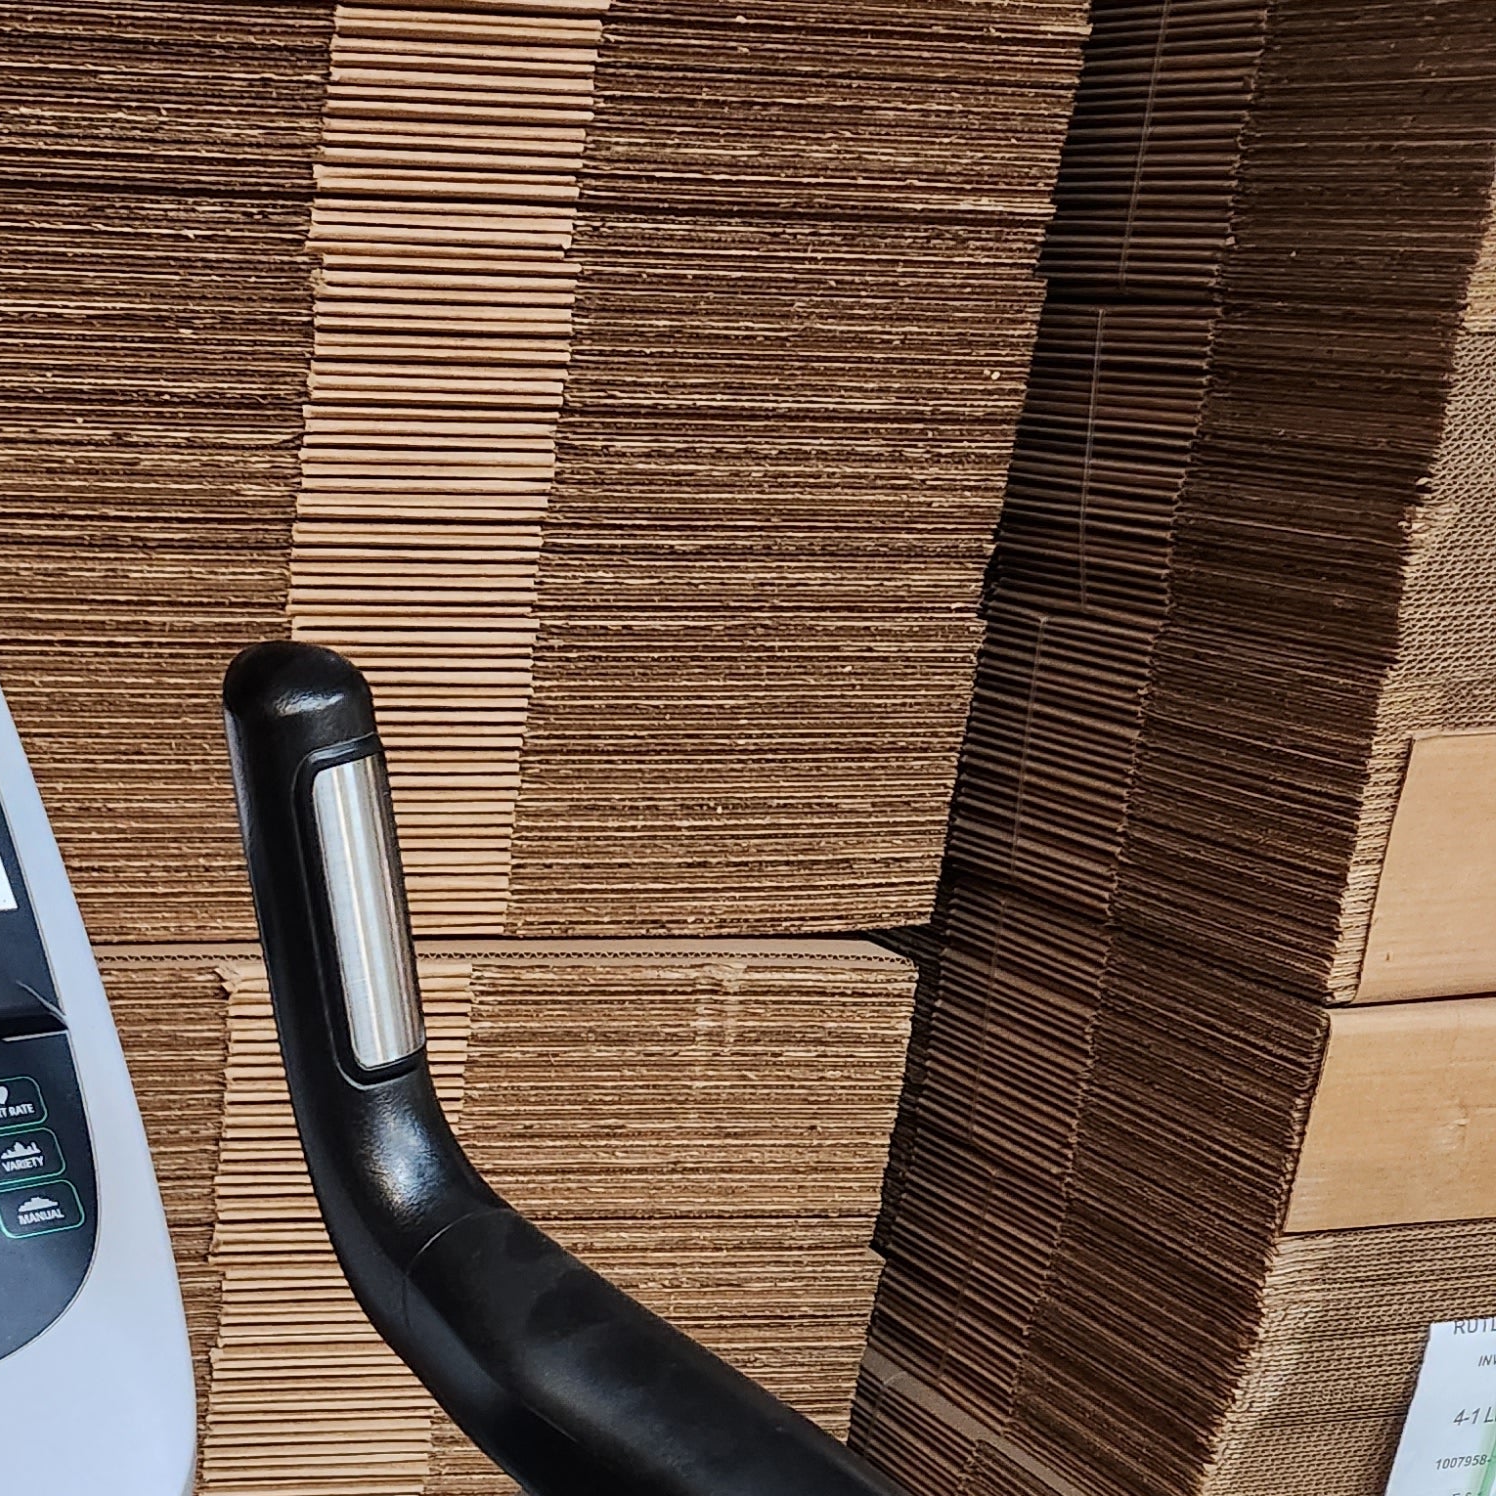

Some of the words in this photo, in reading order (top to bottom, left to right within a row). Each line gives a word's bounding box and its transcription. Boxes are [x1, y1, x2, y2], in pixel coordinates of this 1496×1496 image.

[8, 1103, 36, 1117] RATE
[1, 1155, 45, 1173] VARIETY
[17, 1208, 65, 1225] MANUAL
[1453, 1407, 1481, 1426] 4-1
